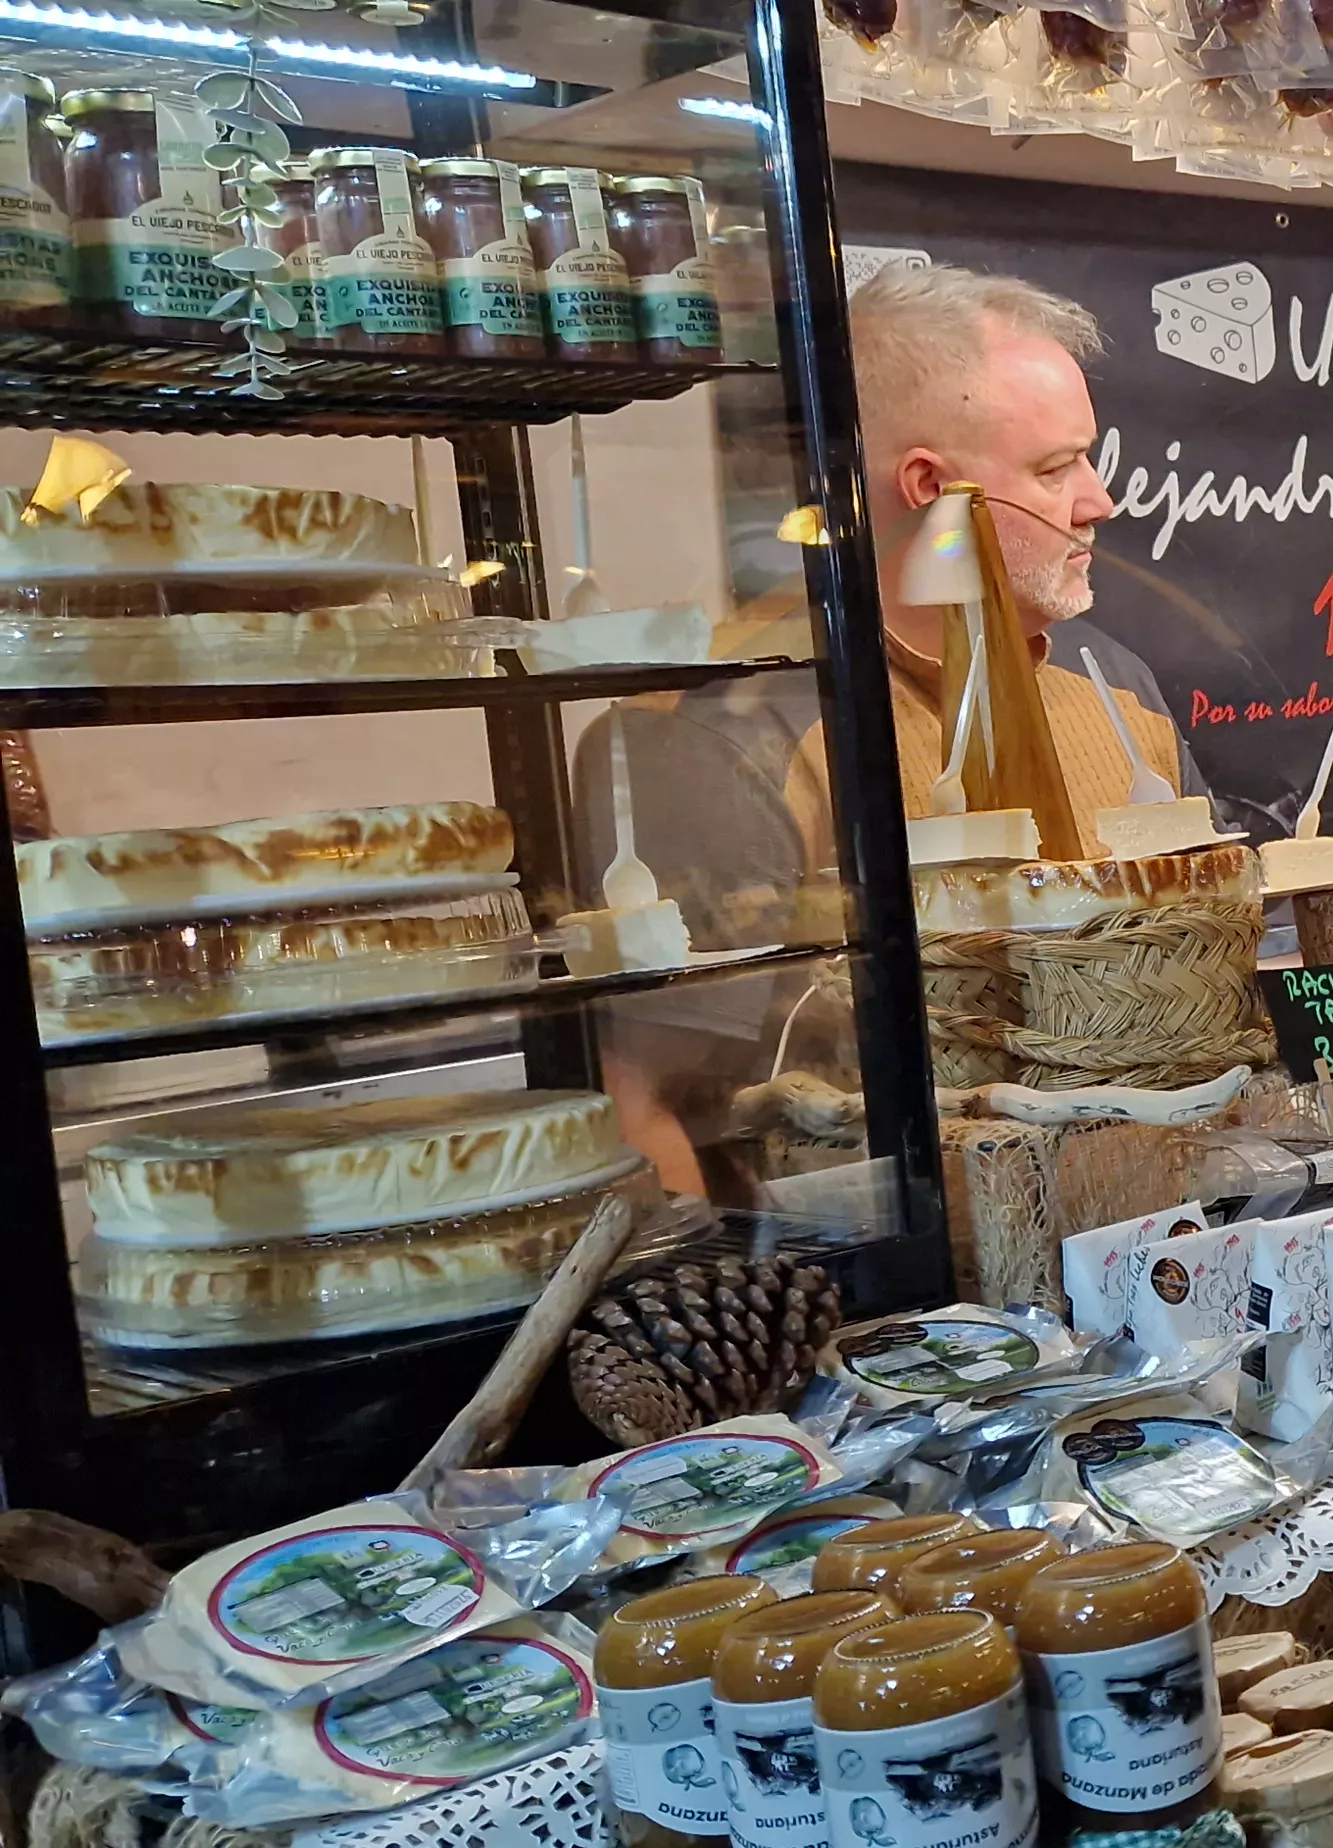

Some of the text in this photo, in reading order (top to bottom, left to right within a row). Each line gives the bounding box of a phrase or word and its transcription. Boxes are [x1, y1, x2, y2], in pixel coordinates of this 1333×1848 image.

[124, 286, 159, 297] DEL
[355, 307, 383, 318] DEL
[1190, 689, 1237, 729] Por
[1244, 702, 1275, 721] su
[1061, 1770, 1176, 1801] Manzana de
[754, 1810, 826, 1831] sturiana
